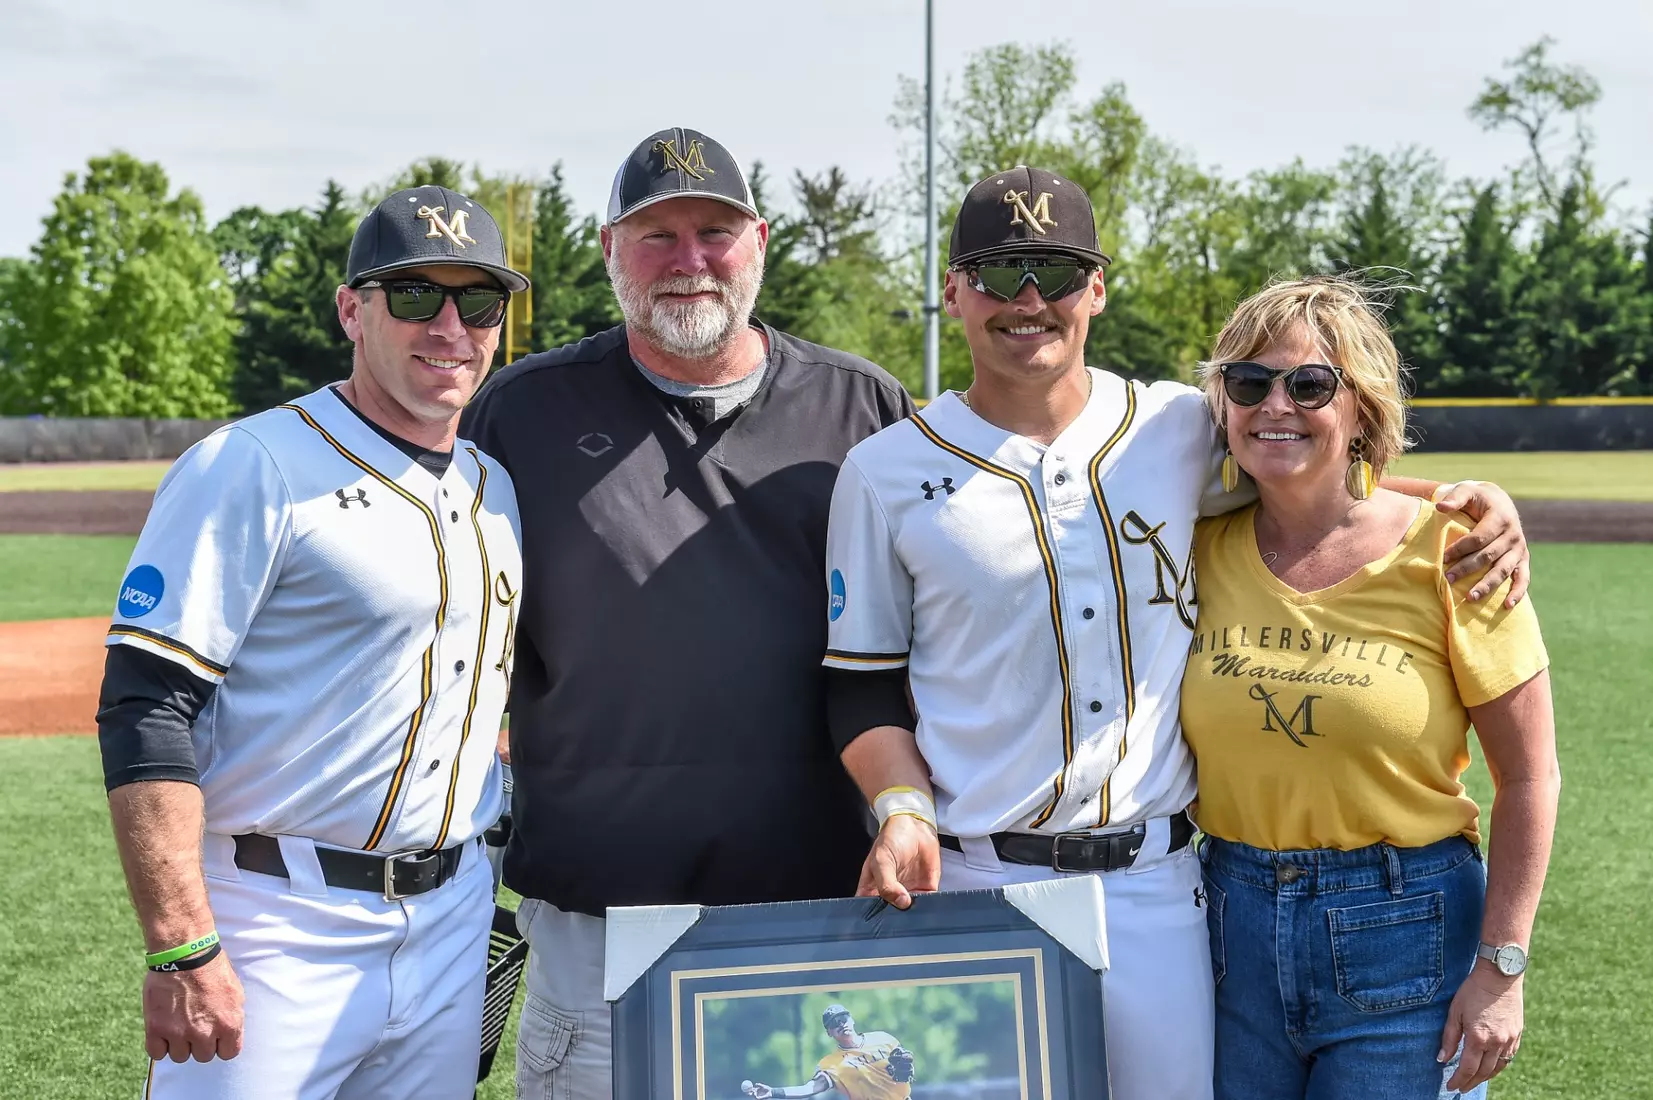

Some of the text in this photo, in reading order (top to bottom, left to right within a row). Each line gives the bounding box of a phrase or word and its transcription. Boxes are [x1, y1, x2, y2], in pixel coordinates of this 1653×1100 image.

[121, 586, 157, 610] NCAA
[1192, 626, 1414, 675] MILLERSVILLE
[1212, 653, 1374, 688] Marauders
